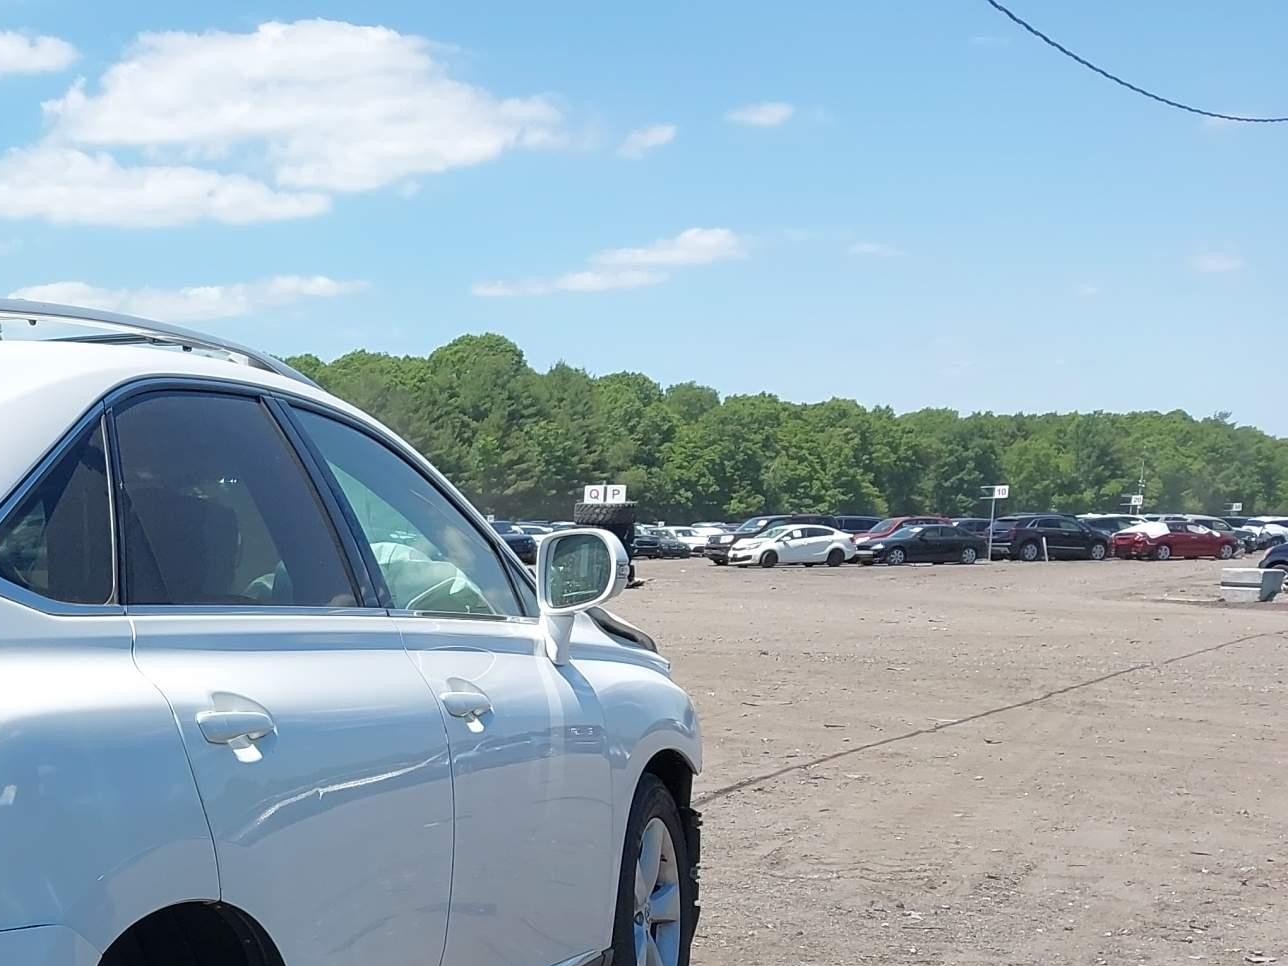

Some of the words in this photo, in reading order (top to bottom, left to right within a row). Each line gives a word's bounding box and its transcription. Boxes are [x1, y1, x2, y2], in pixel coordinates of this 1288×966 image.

[589, 488, 600, 500] Q
[612, 488, 621, 500] P
[997, 488, 1007, 496] 10
